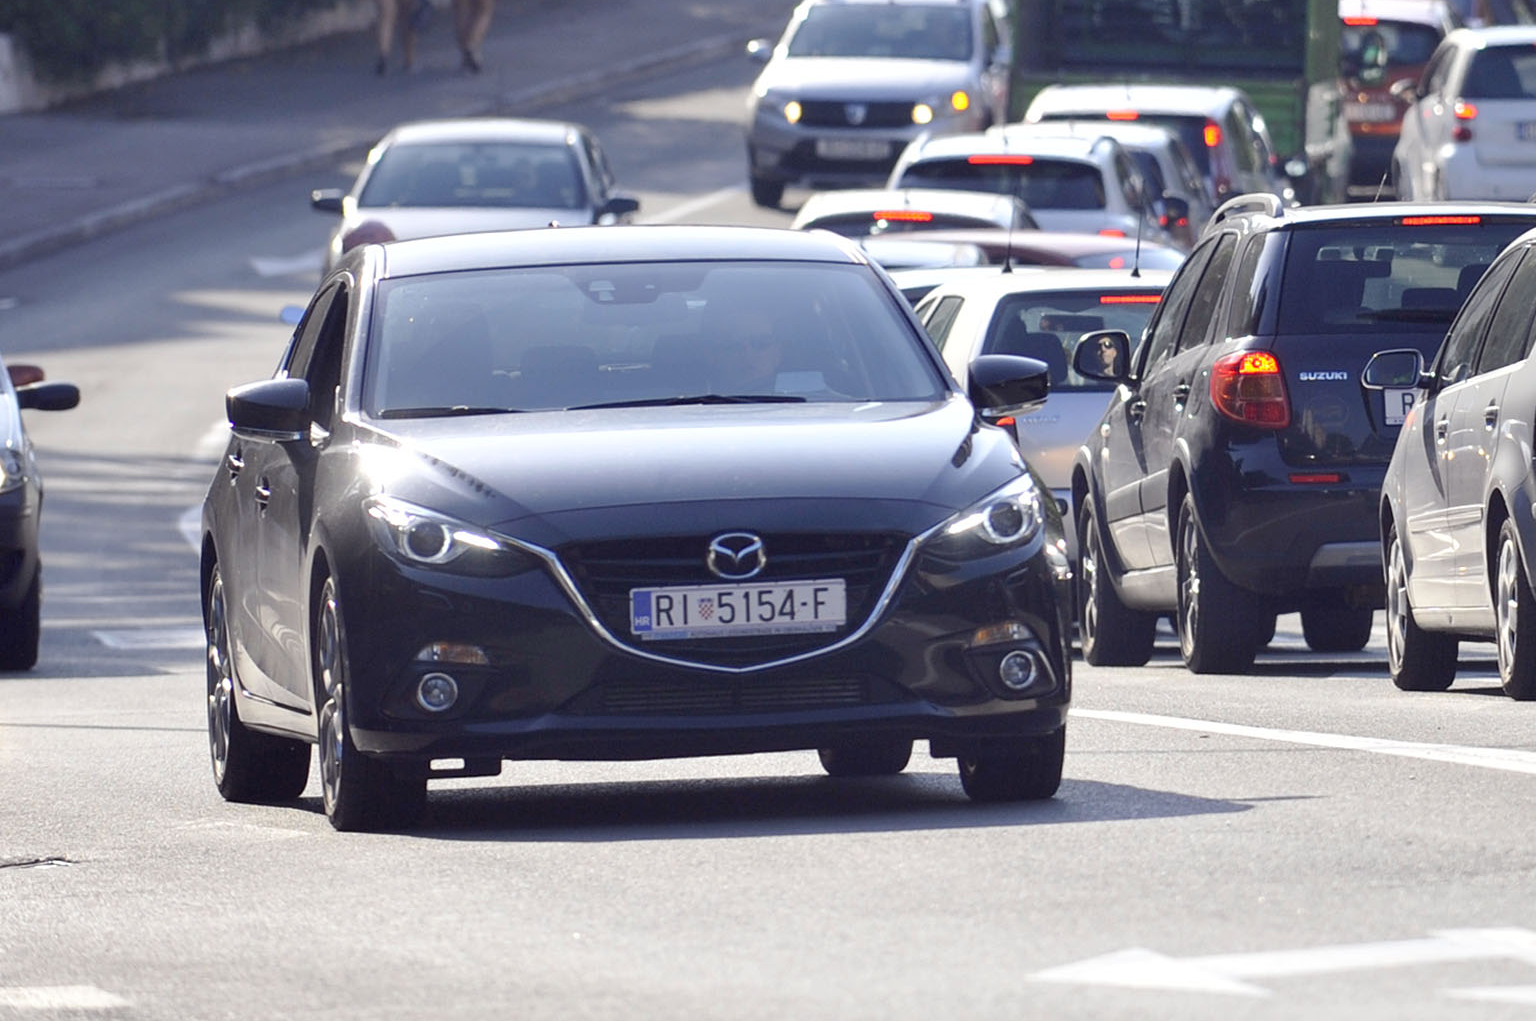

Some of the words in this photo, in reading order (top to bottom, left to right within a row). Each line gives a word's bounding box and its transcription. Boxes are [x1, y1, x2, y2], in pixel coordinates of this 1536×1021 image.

[1299, 371, 1348, 381] SUZUKI
[634, 616, 650, 627] HR
[655, 594, 688, 627] RI
[716, 587, 829, 624] 5154-F
